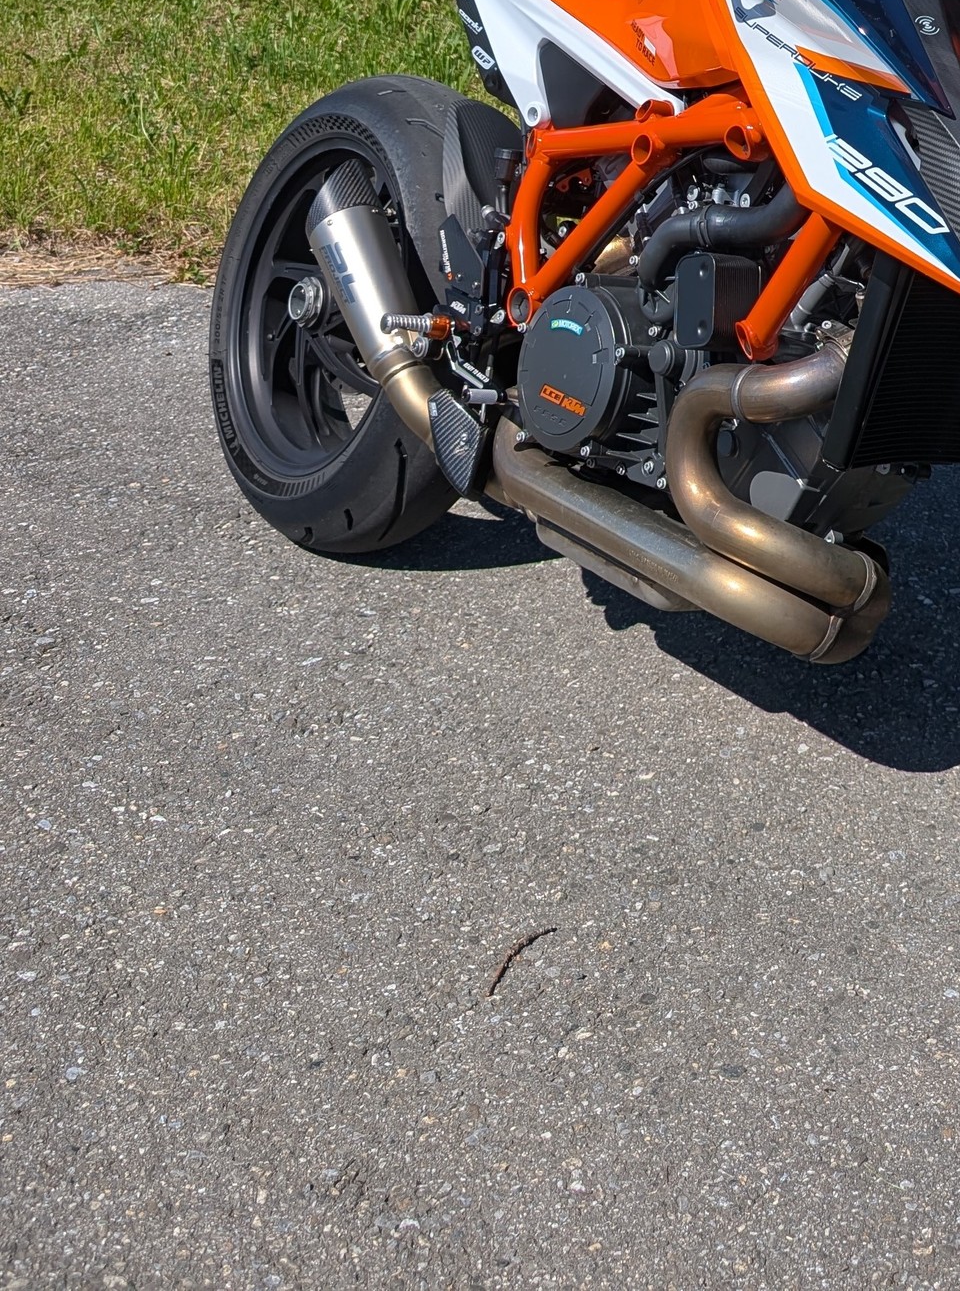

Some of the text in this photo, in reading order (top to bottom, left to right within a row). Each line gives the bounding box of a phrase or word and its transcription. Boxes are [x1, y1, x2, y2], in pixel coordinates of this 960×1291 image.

[473, 48, 493, 67] WP
[642, 45, 655, 66] RACE
[320, 245, 351, 304] PROJECT
[450, 301, 466, 314] KTM
[558, 319, 583, 335] MOTOREX
[213, 366, 234, 439] MICHELIN
[561, 396, 586, 417] KTM
